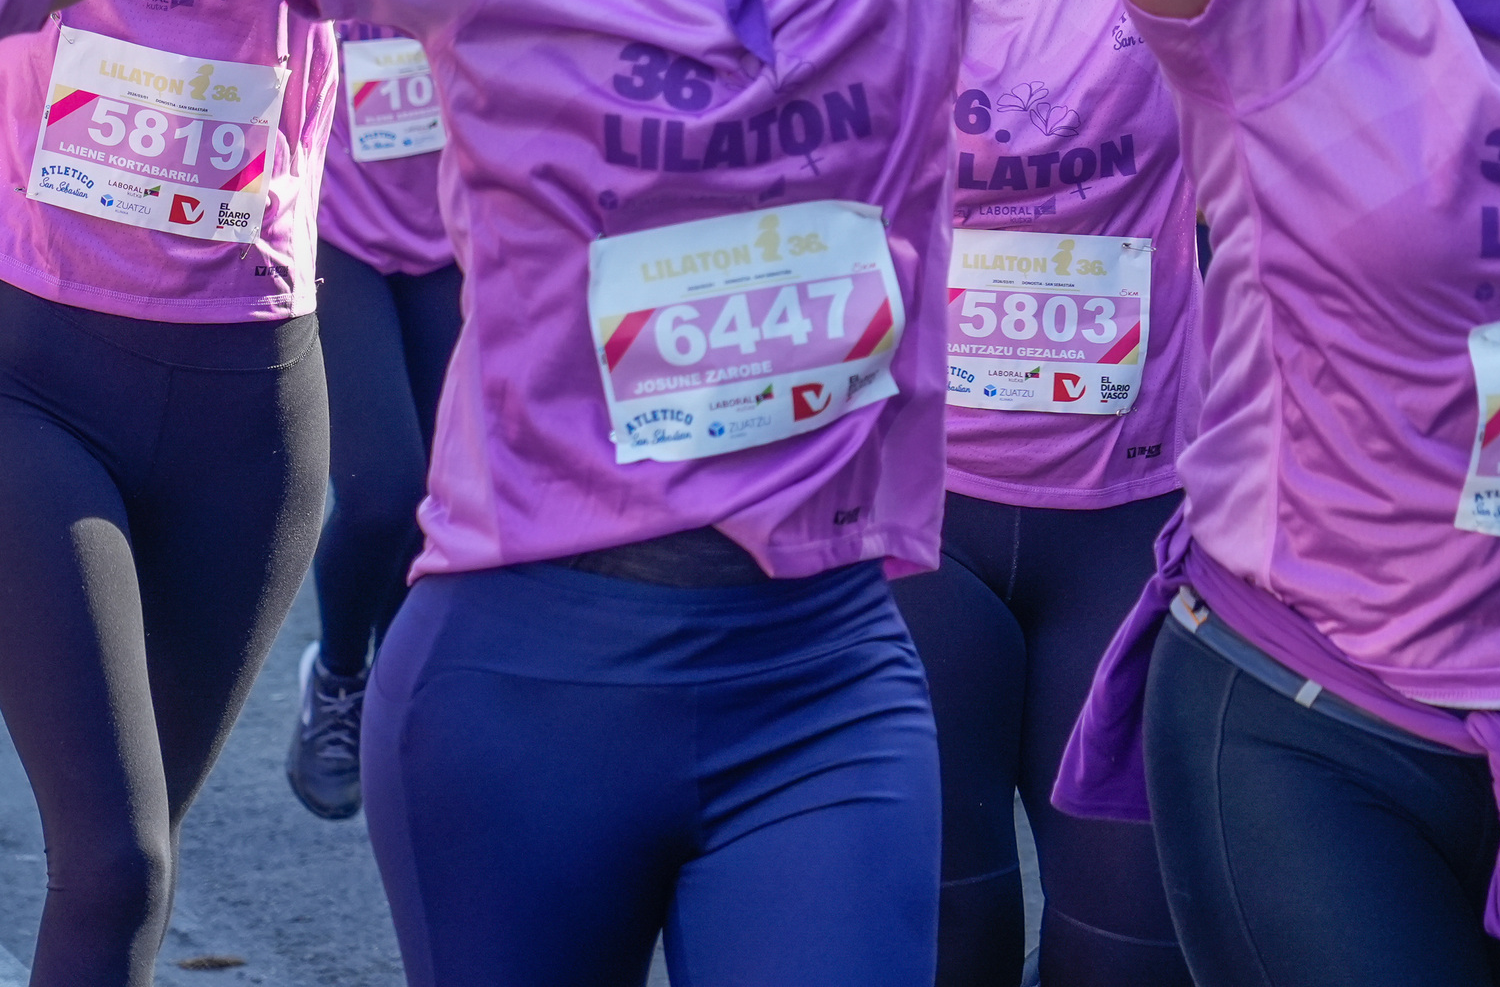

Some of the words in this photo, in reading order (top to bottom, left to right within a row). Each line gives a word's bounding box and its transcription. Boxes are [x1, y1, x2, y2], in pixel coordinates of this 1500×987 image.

[1112, 30, 1136, 51] San
[99, 59, 184, 99] LILATON
[87, 97, 246, 172] 5819
[604, 82, 873, 175] LILATON
[58, 141, 107, 163] LAIENE
[107, 154, 200, 183] KORTABARRIA
[39, 178, 56, 192] San
[41, 165, 95, 190] ATLETICO
[108, 179, 143, 194] LABORAL
[115, 199, 152, 215] ZUATZU
[218, 209, 251, 220] DIARIO
[220, 202, 231, 211] EL
[979, 205, 1032, 216] LABORAL
[217, 217, 248, 228] VASCO
[640, 243, 750, 282] LILATON
[962, 253, 1048, 276] LILATON
[654, 276, 855, 366] 6447
[958, 291, 1118, 344] 5803
[1016, 347, 1086, 360] GEZALAGA
[633, 373, 703, 396] JOSUNE
[705, 360, 774, 384] ZAROBE
[988, 370, 1024, 378] LABORAL
[1101, 376, 1112, 384] EL
[999, 388, 1035, 398] ZUATZU
[1100, 383, 1131, 392] DIARIO
[1100, 391, 1129, 400] VASCO
[709, 397, 754, 412] LABORAL
[625, 408, 694, 435] ATLETICO
[729, 414, 773, 433] ZUATZU
